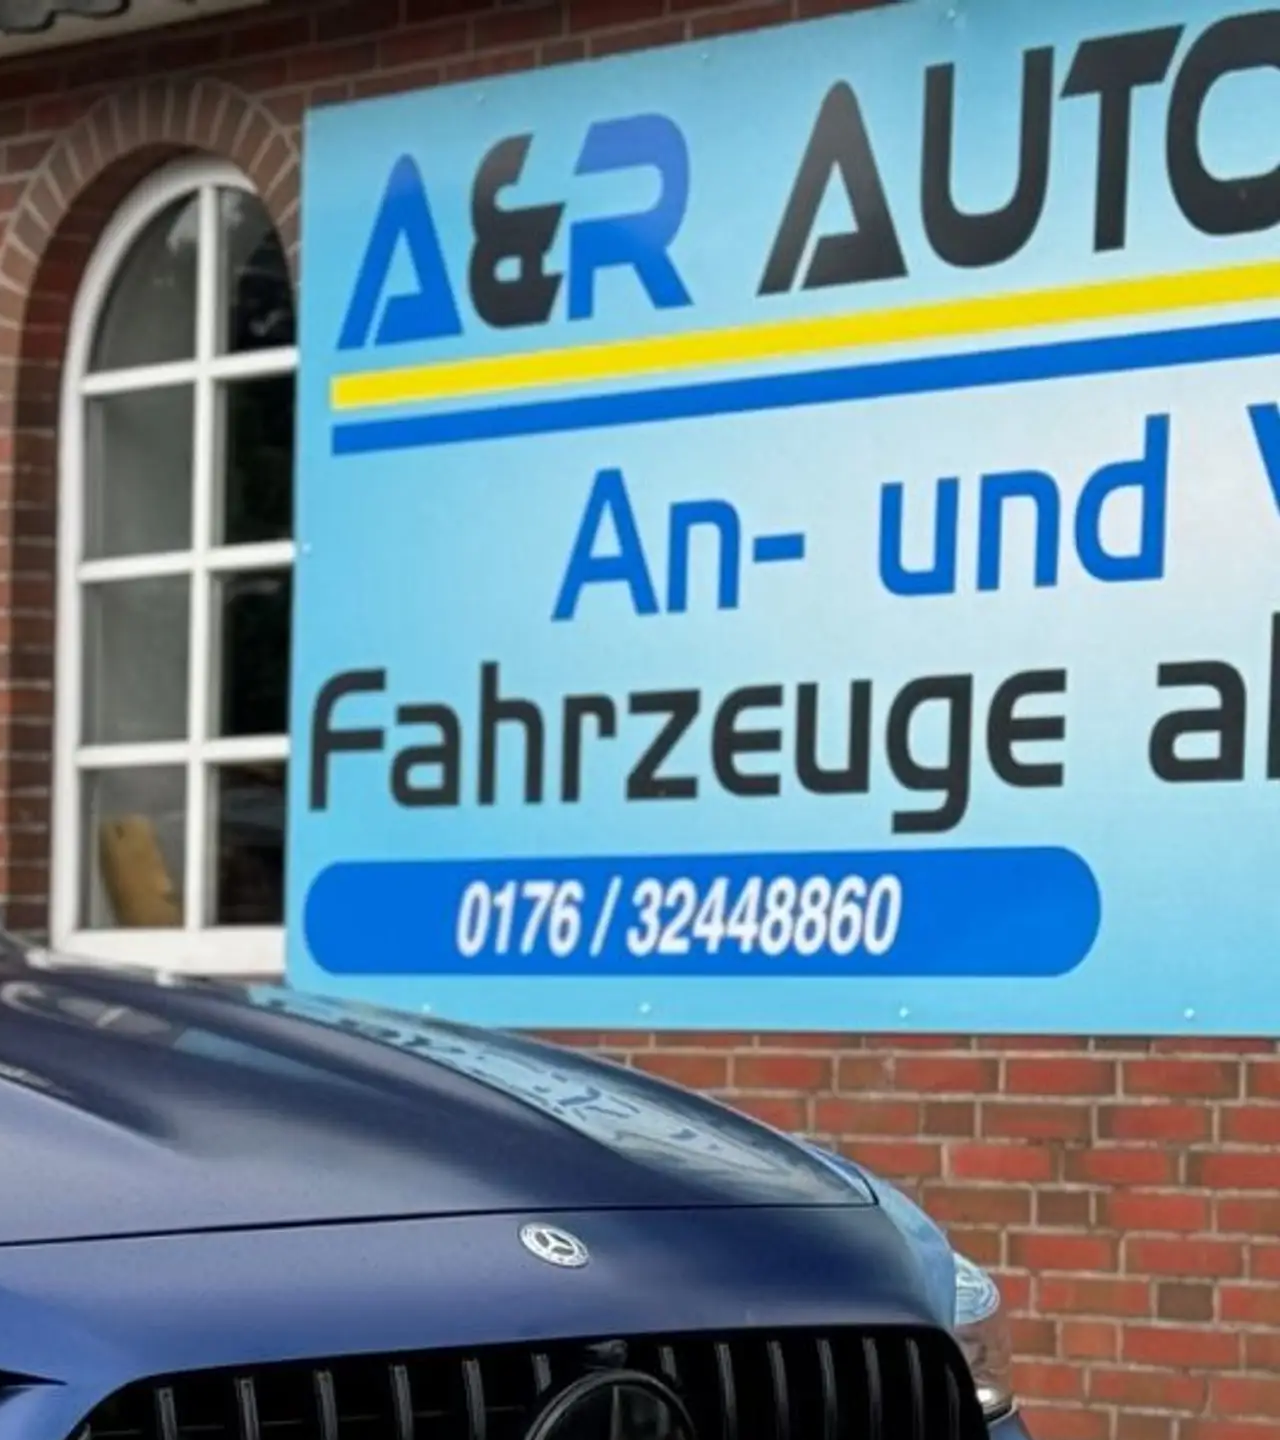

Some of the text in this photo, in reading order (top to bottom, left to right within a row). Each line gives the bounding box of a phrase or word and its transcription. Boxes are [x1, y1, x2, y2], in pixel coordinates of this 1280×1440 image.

[337, 114, 692, 351] A&R
[551, 469, 805, 621] An-
[879, 413, 1169, 596] und
[310, 663, 1066, 833] Fahrzeuge
[457, 881, 583, 956] 0176
[627, 876, 902, 956] 32448860
